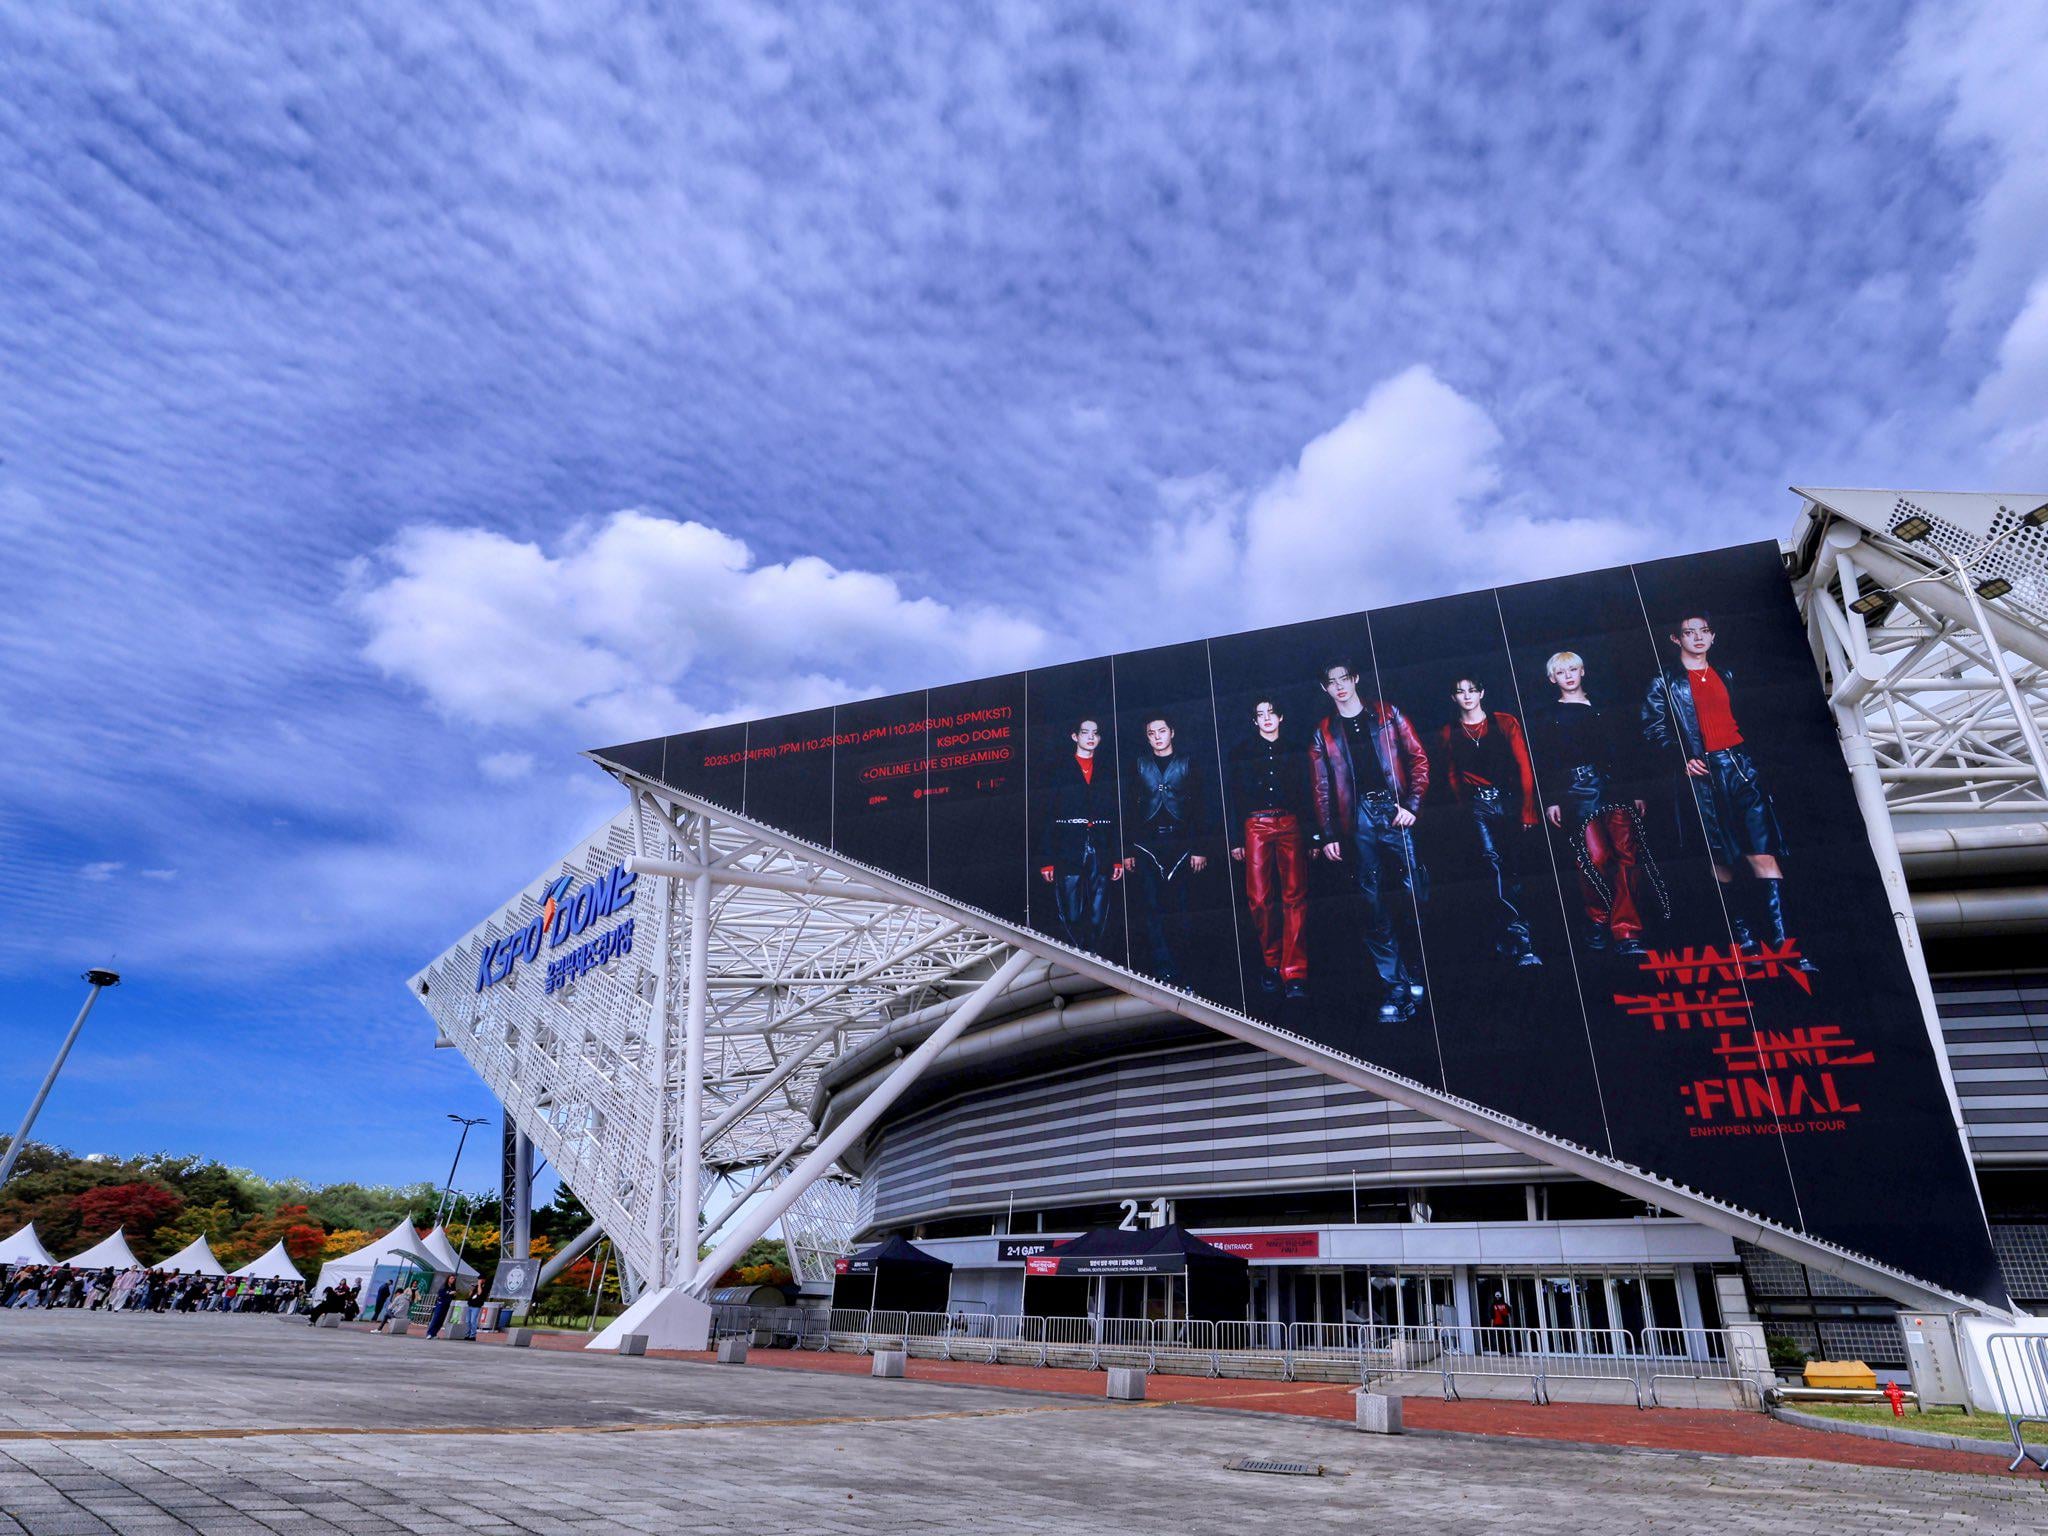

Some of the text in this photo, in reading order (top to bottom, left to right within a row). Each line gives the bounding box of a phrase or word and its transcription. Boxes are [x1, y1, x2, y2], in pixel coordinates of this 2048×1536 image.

[704, 746, 776, 767] 2025.10.24(FRI)
[779, 743, 800, 755] 7PM
[806, 732, 860, 750] 10.25(SAT)
[862, 727, 887, 741] 6PM
[893, 717, 953, 735] 10.26(SUN)
[956, 706, 1012, 725] 5PM(KST)
[937, 727, 1010, 748] KSPO DOME
[914, 759, 937, 772] LIVE
[941, 748, 1010, 768] STREAMING
[476, 862, 638, 993] KSPO DOME
[1639, 937, 1812, 996] WALK
[1613, 987, 1753, 1030] THE
[1713, 1026, 1875, 1071] LINE
[1690, 1120, 1846, 1137] ENHYPEN WORLD TOUR
[1118, 1197, 1167, 1232] 2-1
[1007, 1246, 1020, 1256] 2-1
